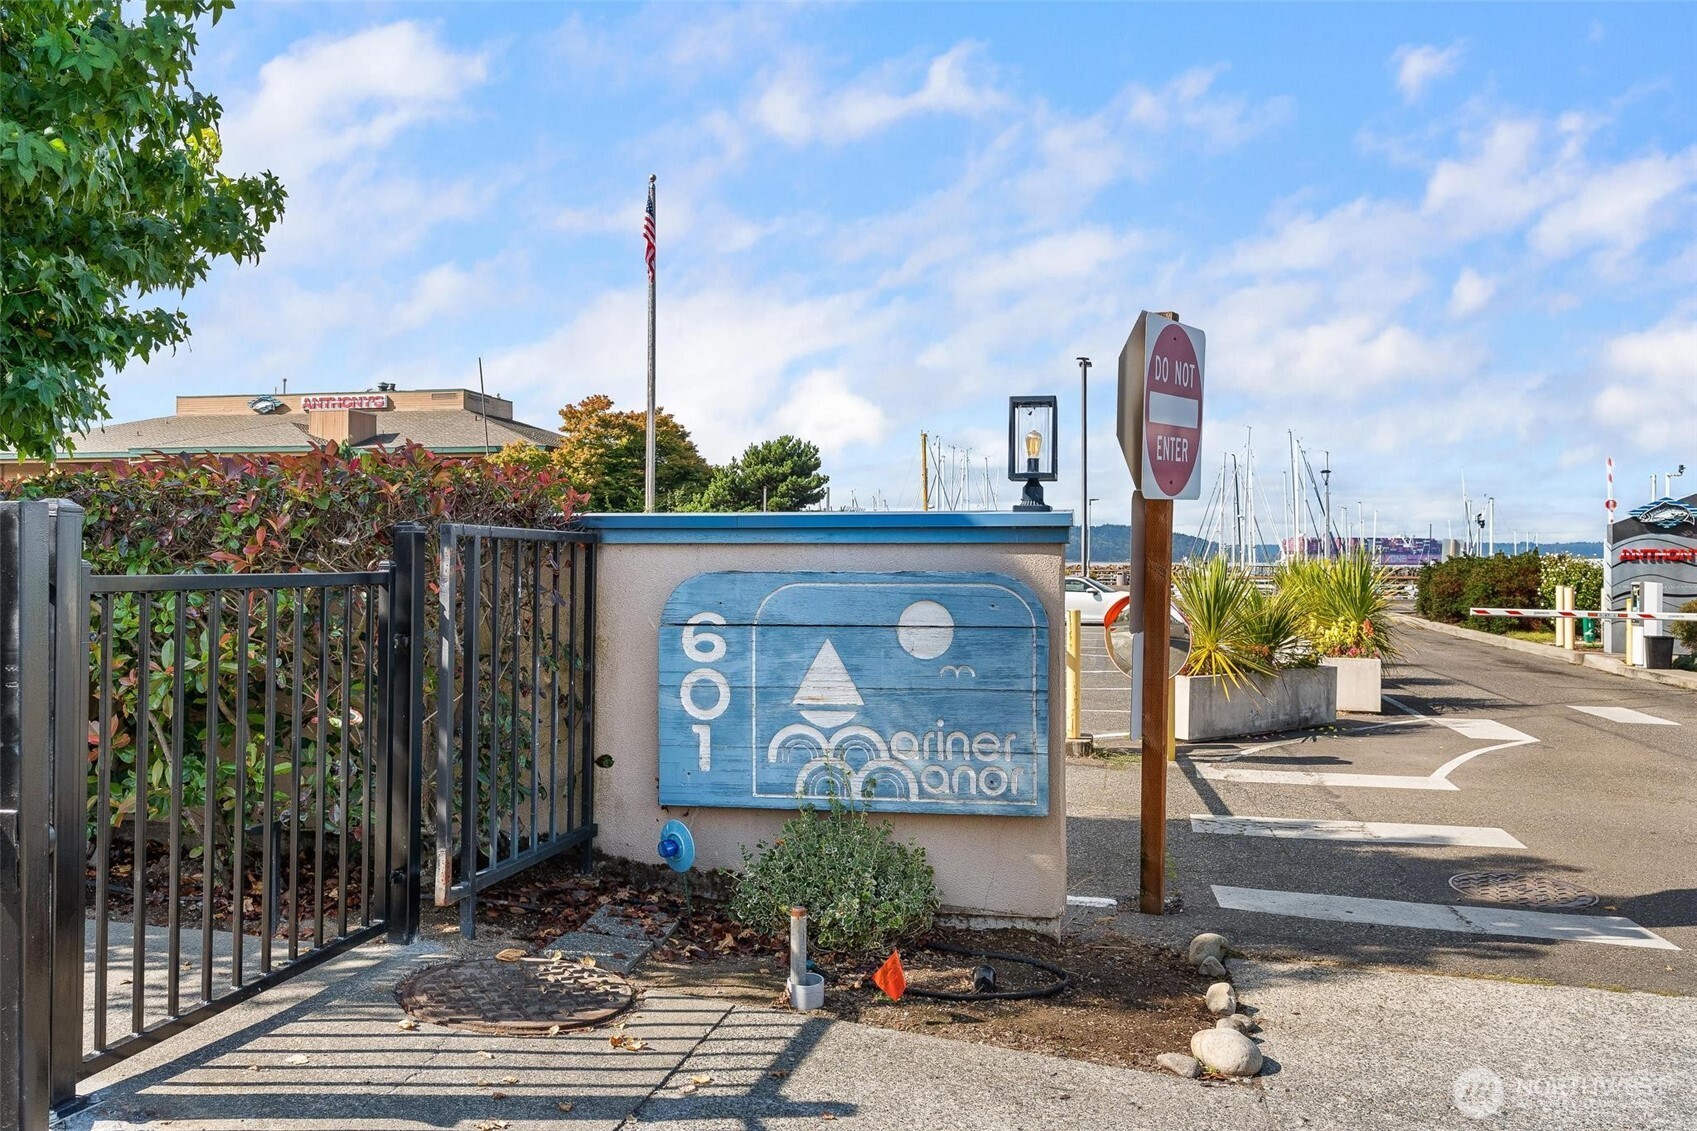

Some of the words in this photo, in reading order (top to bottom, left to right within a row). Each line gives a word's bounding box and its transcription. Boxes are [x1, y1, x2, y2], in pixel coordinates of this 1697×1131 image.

[1154, 354, 1169, 383] DO
[1174, 360, 1196, 388] NOT
[1156, 435, 1189, 462] ENTER
[1619, 548, 1697, 562] ANTHON
[680, 611, 731, 772] 601
